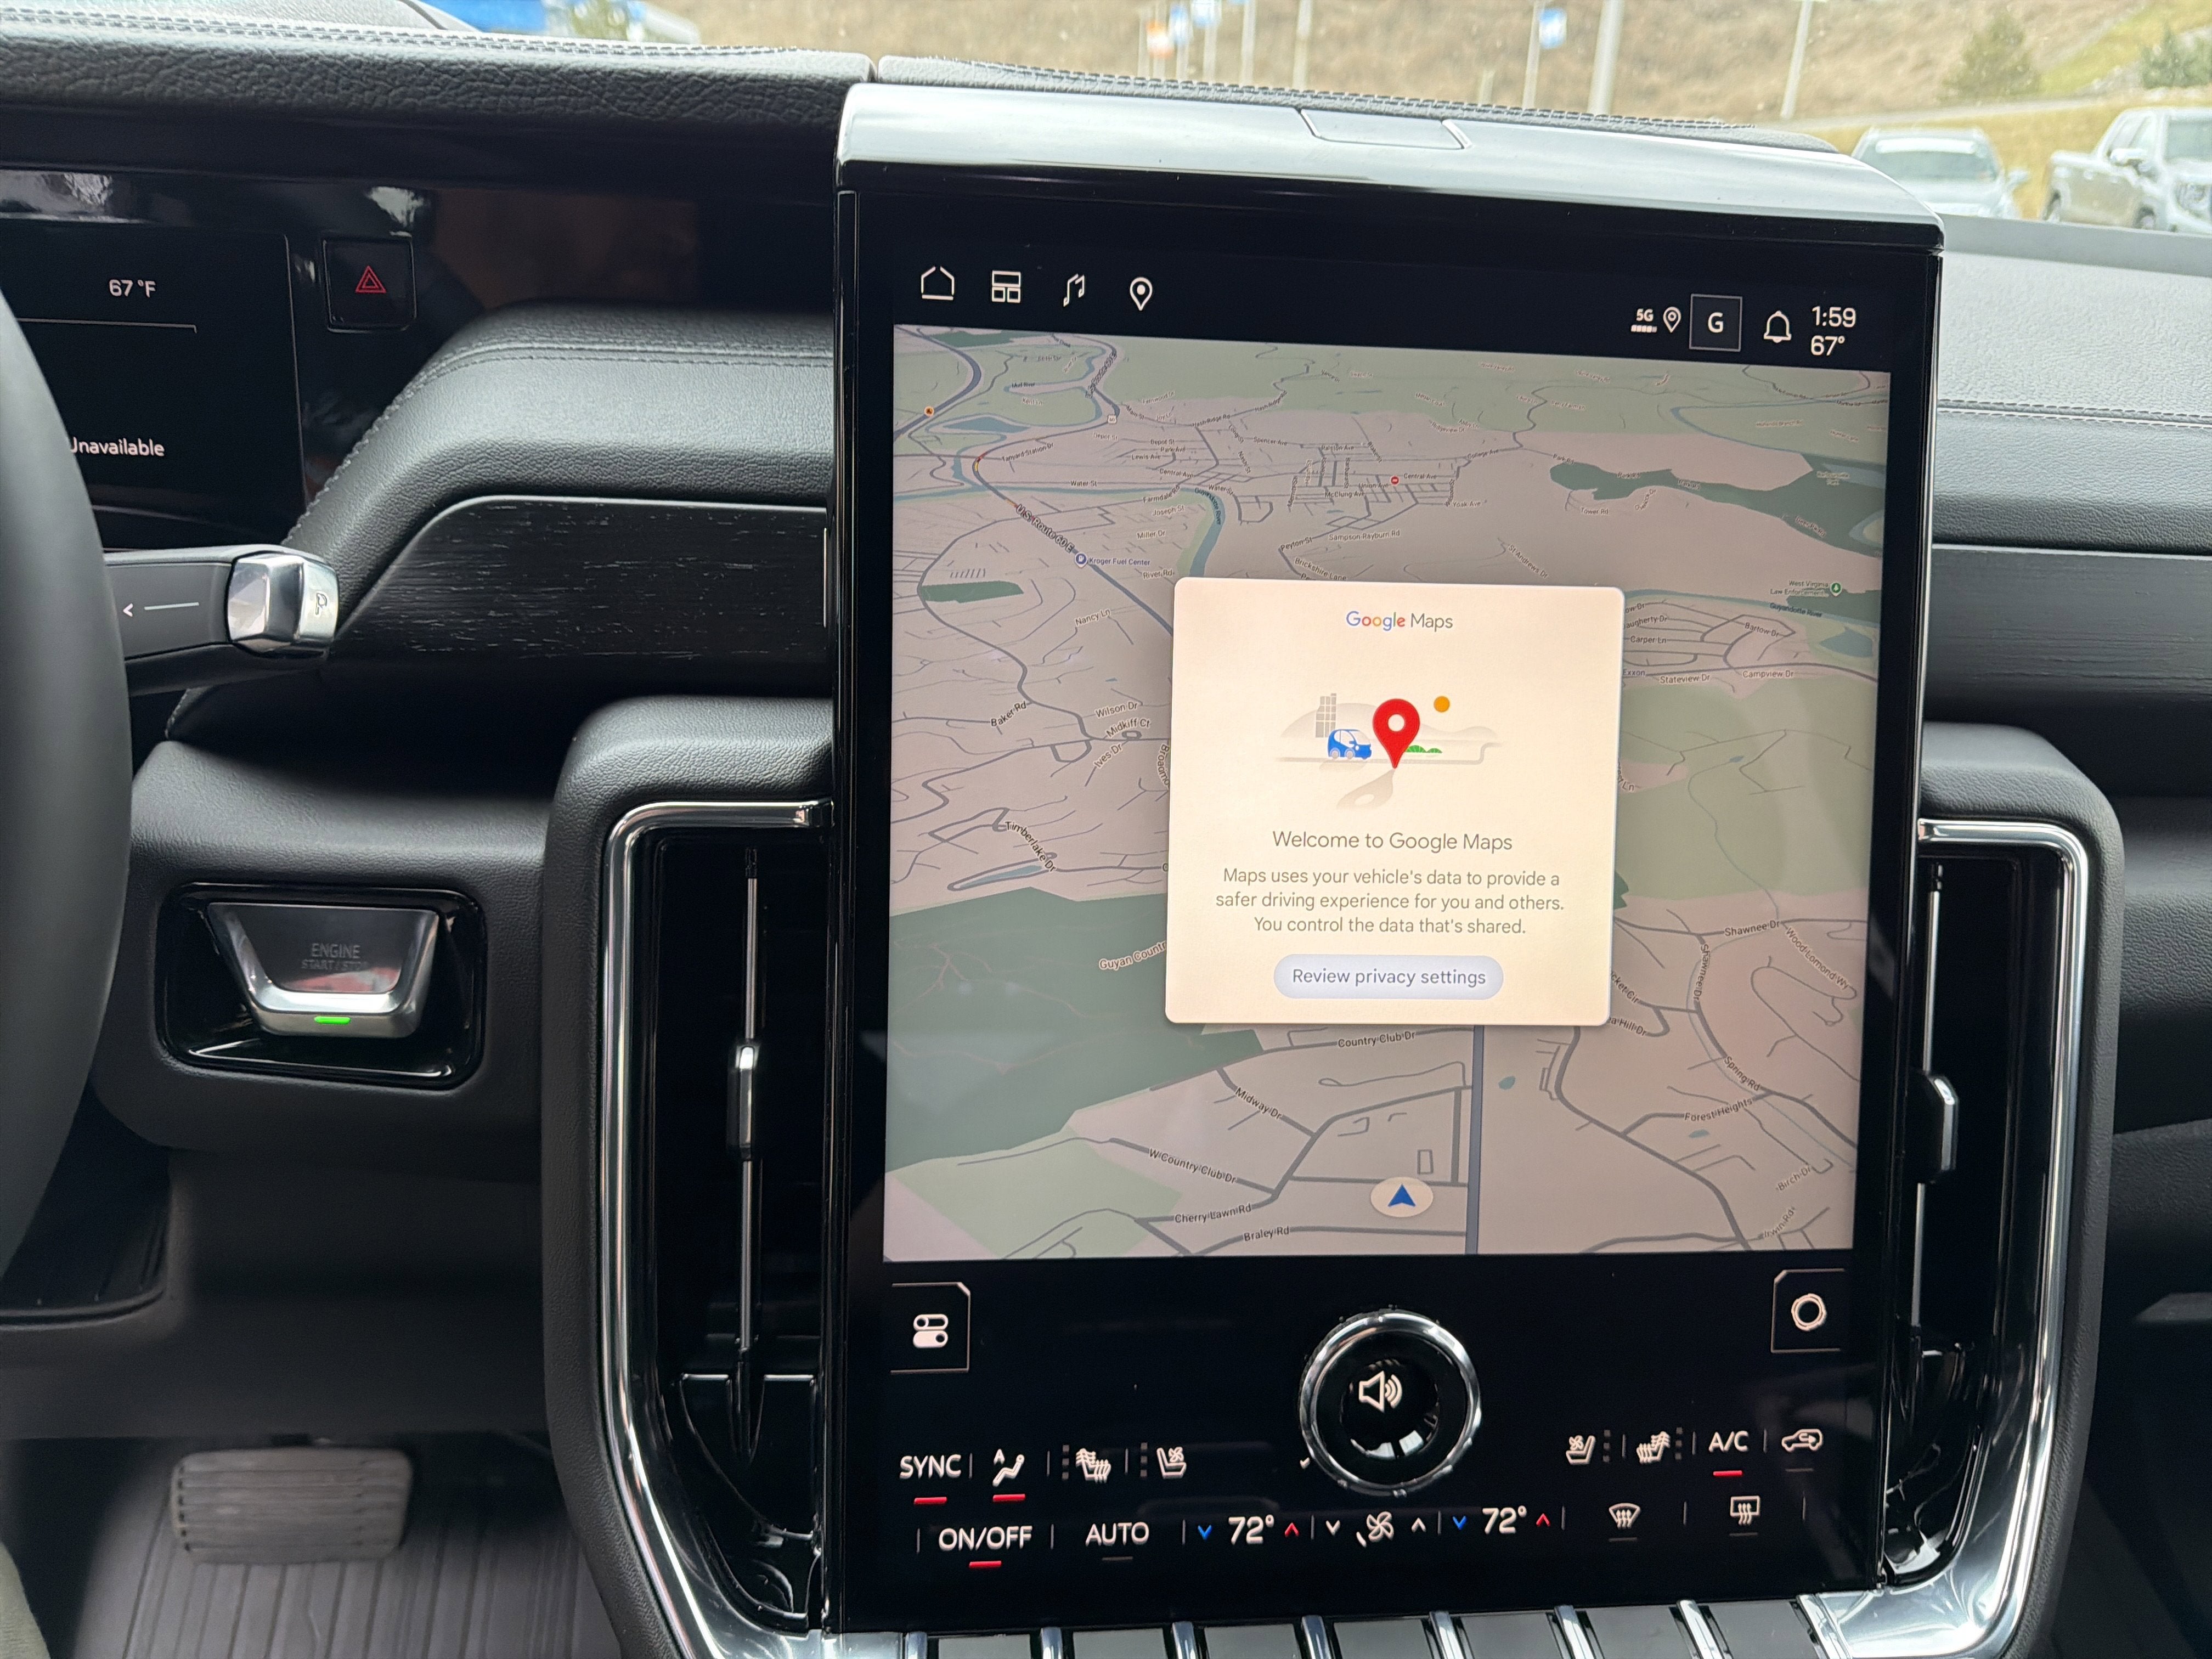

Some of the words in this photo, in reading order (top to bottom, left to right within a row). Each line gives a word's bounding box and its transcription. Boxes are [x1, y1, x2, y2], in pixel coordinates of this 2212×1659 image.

[109, 279, 133, 297] 67
[1636, 308, 1654, 322] 5G
[1707, 312, 1724, 333] G
[1812, 306, 1857, 328] 1:59
[1810, 335, 1846, 356] 67°
[1254, 437, 1276, 445] Spencer
[1159, 468, 1181, 477] Central
[1209, 484, 1226, 492] Water
[1153, 506, 1176, 516] Joseph
[1015, 503, 1032, 521] U.S.
[1032, 516, 1056, 539] Route
[1054, 533, 1069, 547] 60
[1065, 544, 1075, 553] E
[1137, 531, 1155, 539] Miller
[1329, 533, 1361, 541] Sampson
[1362, 531, 1389, 541] Rayburn
[1280, 539, 1304, 551] Peyton
[1143, 571, 1160, 579] River
[1295, 557, 1329, 577] Brickshire
[1637, 603, 1645, 611] Dr
[1076, 612, 1099, 627] Nancy
[1100, 609, 1111, 619] Ln
[1346, 611, 1405, 631] Google
[1410, 613, 1453, 633] Maps
[1624, 617, 1657, 630] augherty
[1659, 615, 1668, 623] Dr
[1745, 622, 1768, 635] Bartow
[1770, 629, 1780, 637] Dr
[1630, 636, 1655, 645] Carper
[1660, 675, 1699, 684] Stateview
[1742, 670, 1782, 680] Campview
[990, 707, 1014, 727] Baker
[1014, 701, 1027, 712] Rd
[1096, 704, 1125, 719] Wilson
[1127, 702, 1138, 711] Dr
[1106, 719, 1138, 737] Midkiff
[1139, 718, 1152, 729] Ct
[1094, 752, 1111, 769] Ives
[1110, 744, 1122, 755] Dr
[1157, 744, 1171, 790] Broadmo
[1622, 781, 1634, 791] Ln
[1005, 821, 1046, 862] Timberlake
[1045, 859, 1057, 873] Dr
[1272, 831, 1359, 848] Welcome
[1364, 833, 1384, 849] to
[1389, 832, 1458, 854] Google
[1463, 833, 1513, 854] Maps
[1223, 867, 1266, 887] Maps
[1271, 872, 1308, 883] uses
[1313, 872, 1349, 887] your
[1353, 868, 1422, 884] vehicle's
[1426, 869, 1462, 885] data
[1466, 872, 1482, 885] to
[1487, 870, 1546, 889] provide
[1550, 874, 1559, 886] a
[1216, 891, 1257, 907] safer
[1262, 891, 1314, 911] driving
[1320, 893, 1409, 911] experience
[1414, 893, 1436, 909] for
[1441, 898, 1470, 912] you
[1475, 894, 1504, 910] and
[1509, 894, 1564, 910] others.
[1254, 917, 1282, 932] You
[1287, 917, 1343, 932] control
[1348, 917, 1374, 932] the
[1379, 917, 1414, 933] data
[1419, 917, 1463, 933] that's
[1467, 918, 1526, 934] shared.
[1725, 922, 1767, 936] Shawnee
[1769, 919, 1780, 928] Dr
[312, 943, 360, 959] ENGINE
[1098, 955, 1133, 970] Guyan
[1134, 941, 1166, 961] Countr
[1787, 927, 1808, 955] Wood
[1806, 950, 1837, 981] Lomond
[1833, 972, 1849, 990] Wy
[1695, 944, 1709, 988] Shawnee
[1293, 968, 1350, 983] Review
[1355, 968, 1416, 988] privacy
[1421, 969, 1486, 988] settings
[1626, 990, 1639, 1004] Cir
[1693, 989, 1702, 1001] Dr
[1619, 1019, 1635, 1031] Hill
[1635, 1025, 1647, 1036] Dr
[1338, 1036, 1377, 1048] Country
[1379, 1032, 1401, 1043] Club
[1403, 1030, 1415, 1041] Dr
[1723, 1056, 1747, 1084] Spring
[1747, 1077, 1761, 1091] Rd
[1234, 1087, 1271, 1113] Midway
[1269, 1107, 1282, 1120] Dr
[1684, 1110, 1716, 1121] Forest
[1717, 1097, 1753, 1118] Heights
[1149, 1149, 1160, 1159] W
[1160, 1152, 1200, 1174] Country
[1200, 1165, 1224, 1181] Club
[1224, 1173, 1237, 1183] Dr
[1777, 1173, 1800, 1192] Birch
[1798, 1165, 1812, 1177] Dr
[1174, 1212, 1207, 1224] Cherry
[1209, 1208, 1235, 1220] Lawn
[1238, 1204, 1252, 1214] Rd
[1243, 1228, 1274, 1242] Braley
[1276, 1226, 1290, 1235] Rd
[1708, 1430, 1749, 1453] A/C
[899, 1453, 962, 1480] SYNC
[1228, 1514, 1274, 1545] 72°
[1482, 1505, 1527, 1534] 72°
[938, 1525, 1033, 1551] ON/OFF
[1085, 1521, 1150, 1547] AUTO
